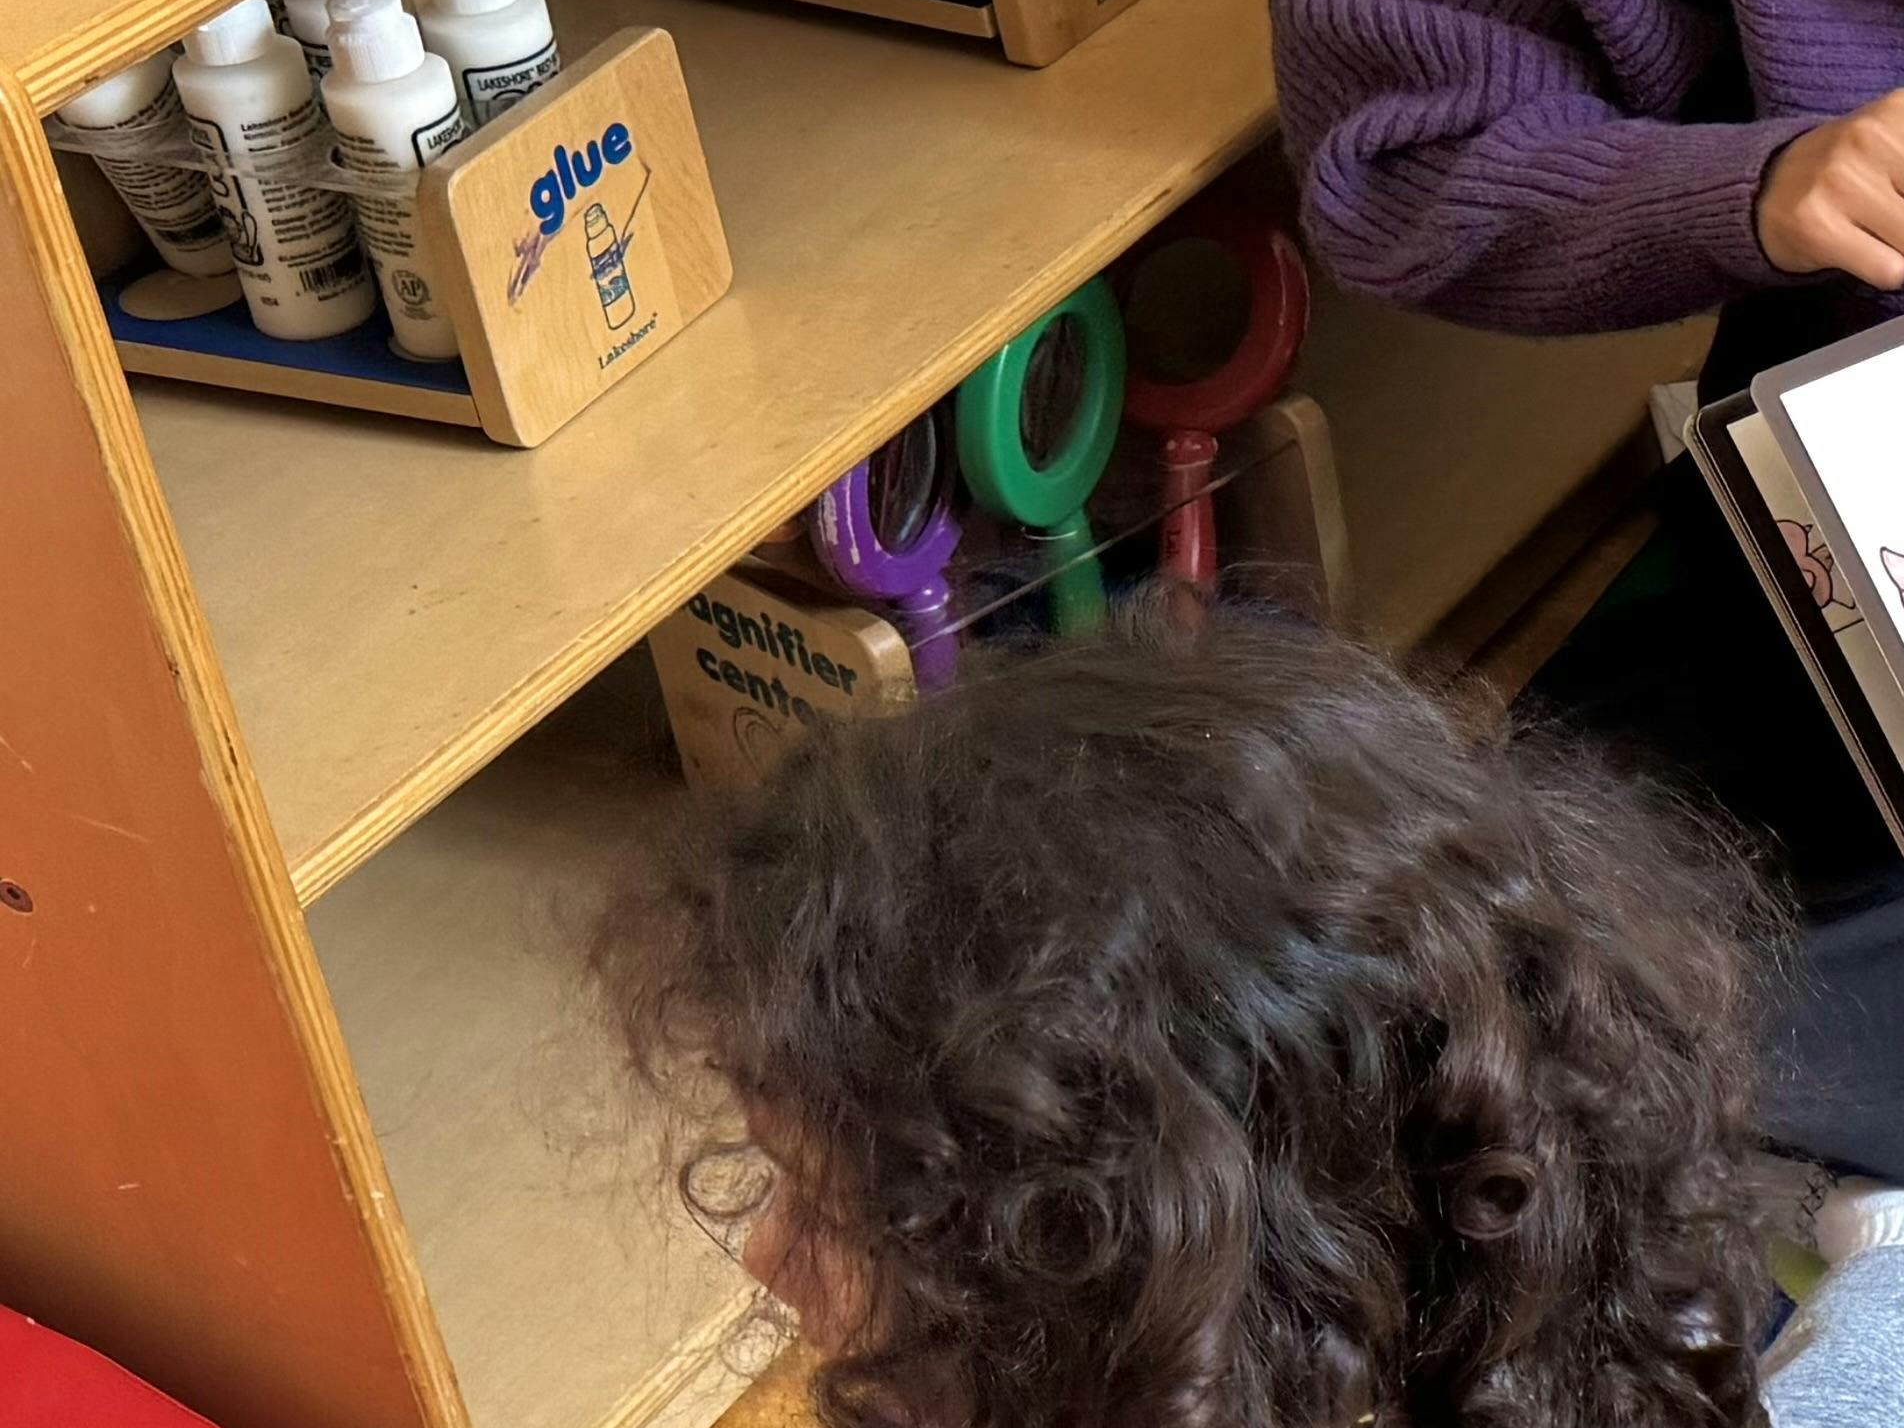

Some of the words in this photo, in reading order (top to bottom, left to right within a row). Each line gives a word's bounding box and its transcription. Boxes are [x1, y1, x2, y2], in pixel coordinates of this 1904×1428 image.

[530, 123, 632, 235] glue
[598, 317, 657, 370] Lakeshore
[687, 592, 857, 696] agnifier
